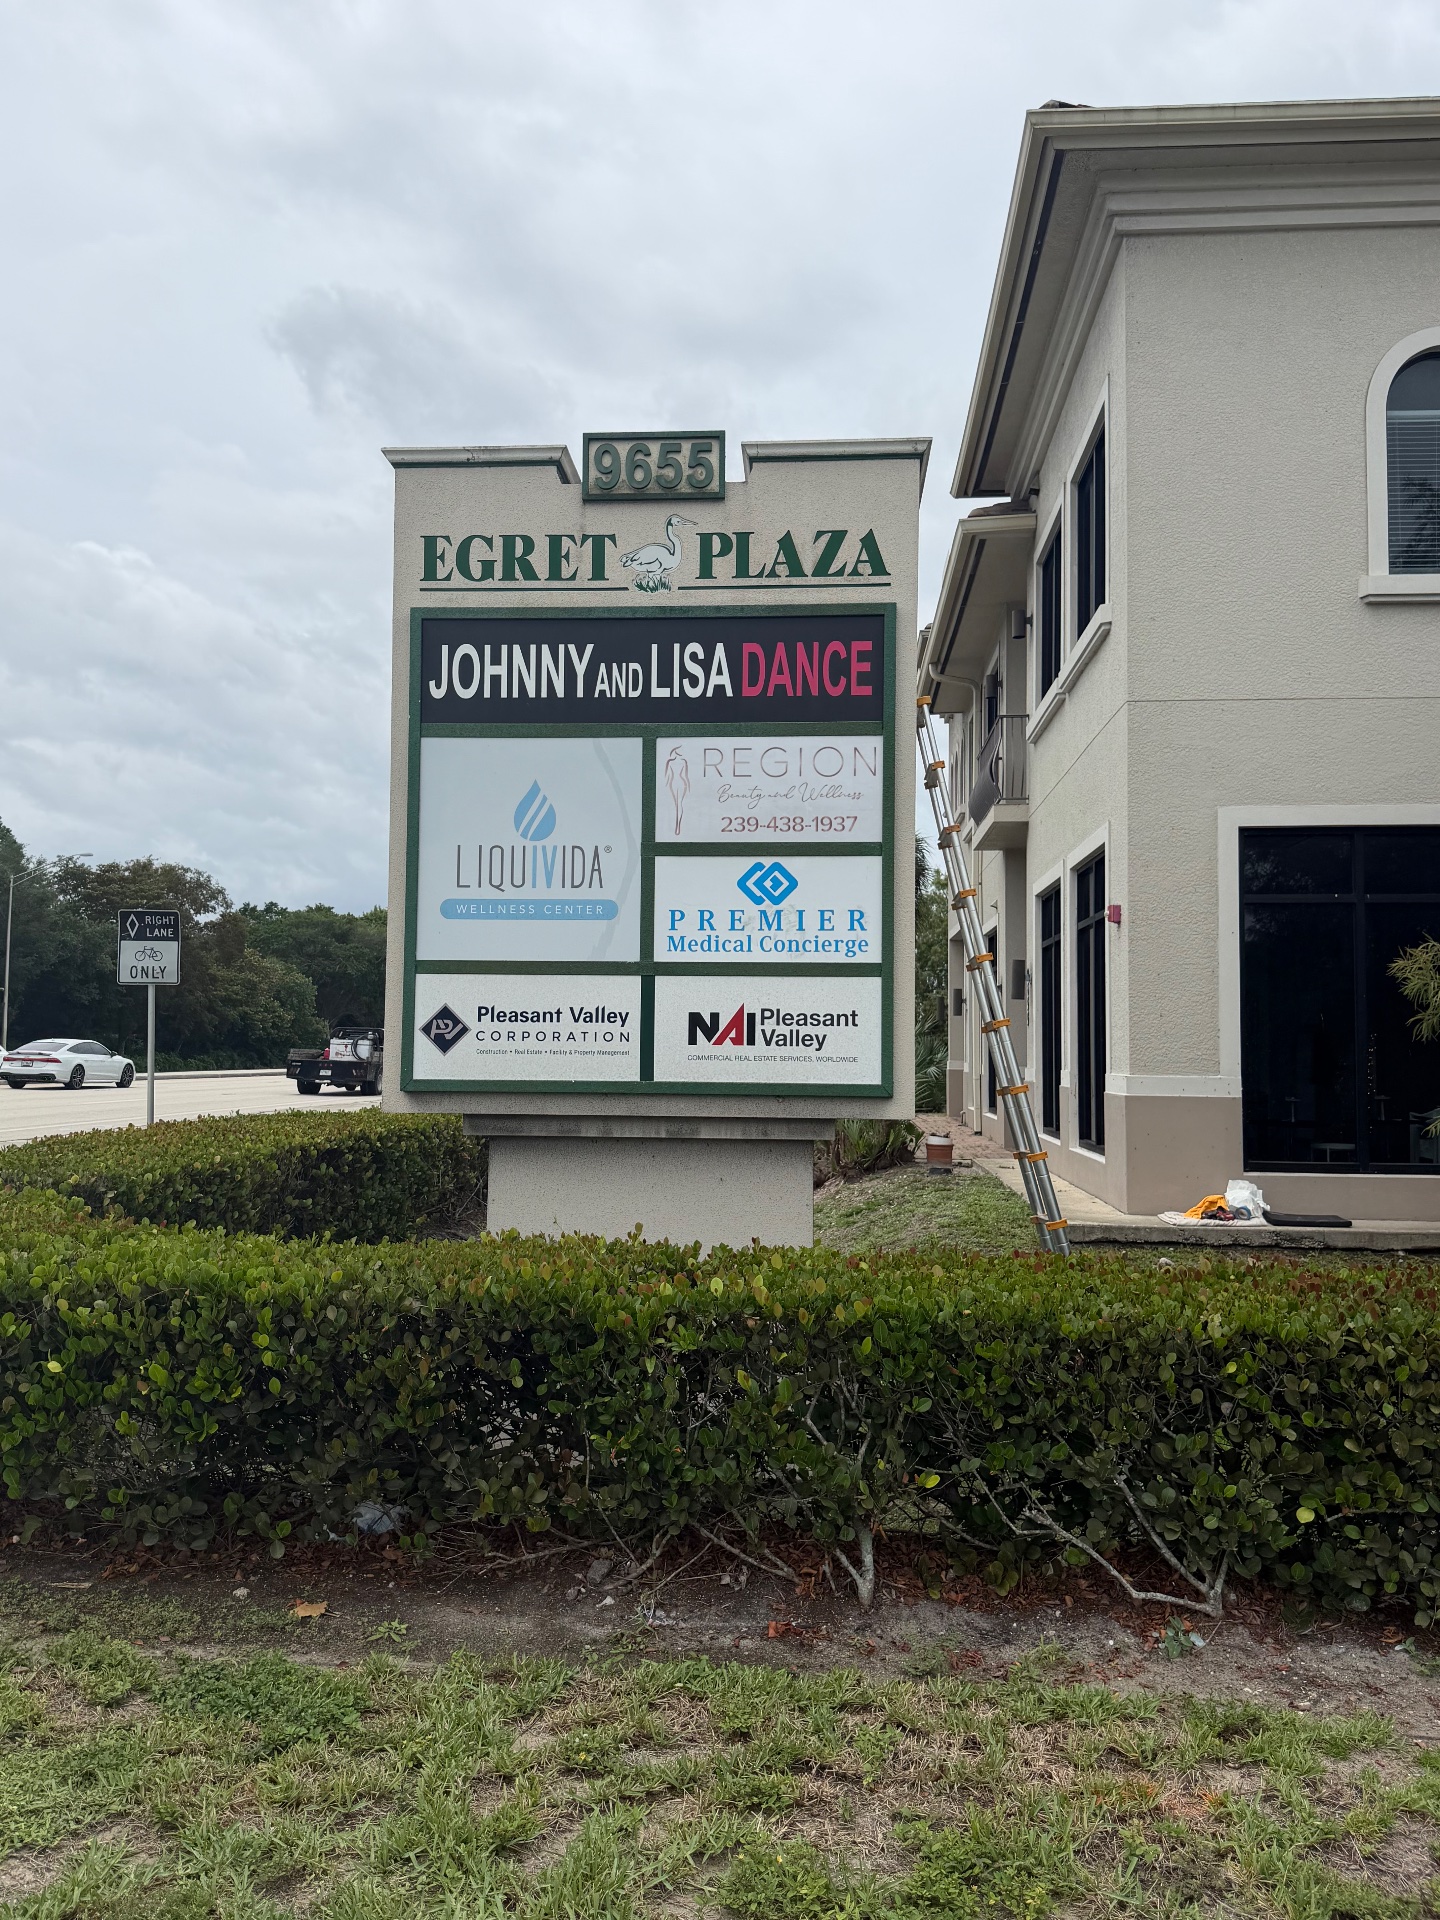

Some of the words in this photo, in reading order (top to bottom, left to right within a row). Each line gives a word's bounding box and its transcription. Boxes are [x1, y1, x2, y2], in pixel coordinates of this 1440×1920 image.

[594, 441, 714, 490] 9655
[420, 533, 617, 582] EGRET
[696, 528, 891, 579] PLAZA
[428, 642, 595, 699] JOHNNY
[594, 661, 643, 698] AND
[650, 641, 733, 698] LISA
[741, 640, 874, 697] DANCE
[703, 746, 877, 778] REGION
[716, 783, 766, 810] Beauty
[767, 785, 797, 800] and
[798, 782, 864, 803] Wellness
[720, 815, 858, 833] 239-438-1937
[145, 915, 176, 925] RIGHT
[456, 904, 535, 914] WELLNESS
[544, 905, 604, 915] CENTER
[668, 909, 868, 932] PREMIER
[146, 928, 174, 937] LANE
[666, 935, 753, 953] Medical
[759, 935, 869, 958] Concierge
[130, 965, 167, 979] ONLY
[477, 1005, 563, 1023] Pleasant
[569, 1005, 630, 1028] Valley
[687, 1002, 757, 1046] NAI
[760, 1008, 859, 1028] Pleasant
[475, 1030, 631, 1043] CORPORATION
[761, 1028, 827, 1051] Valley
[687, 1054, 733, 1062] COMMERCIAL
